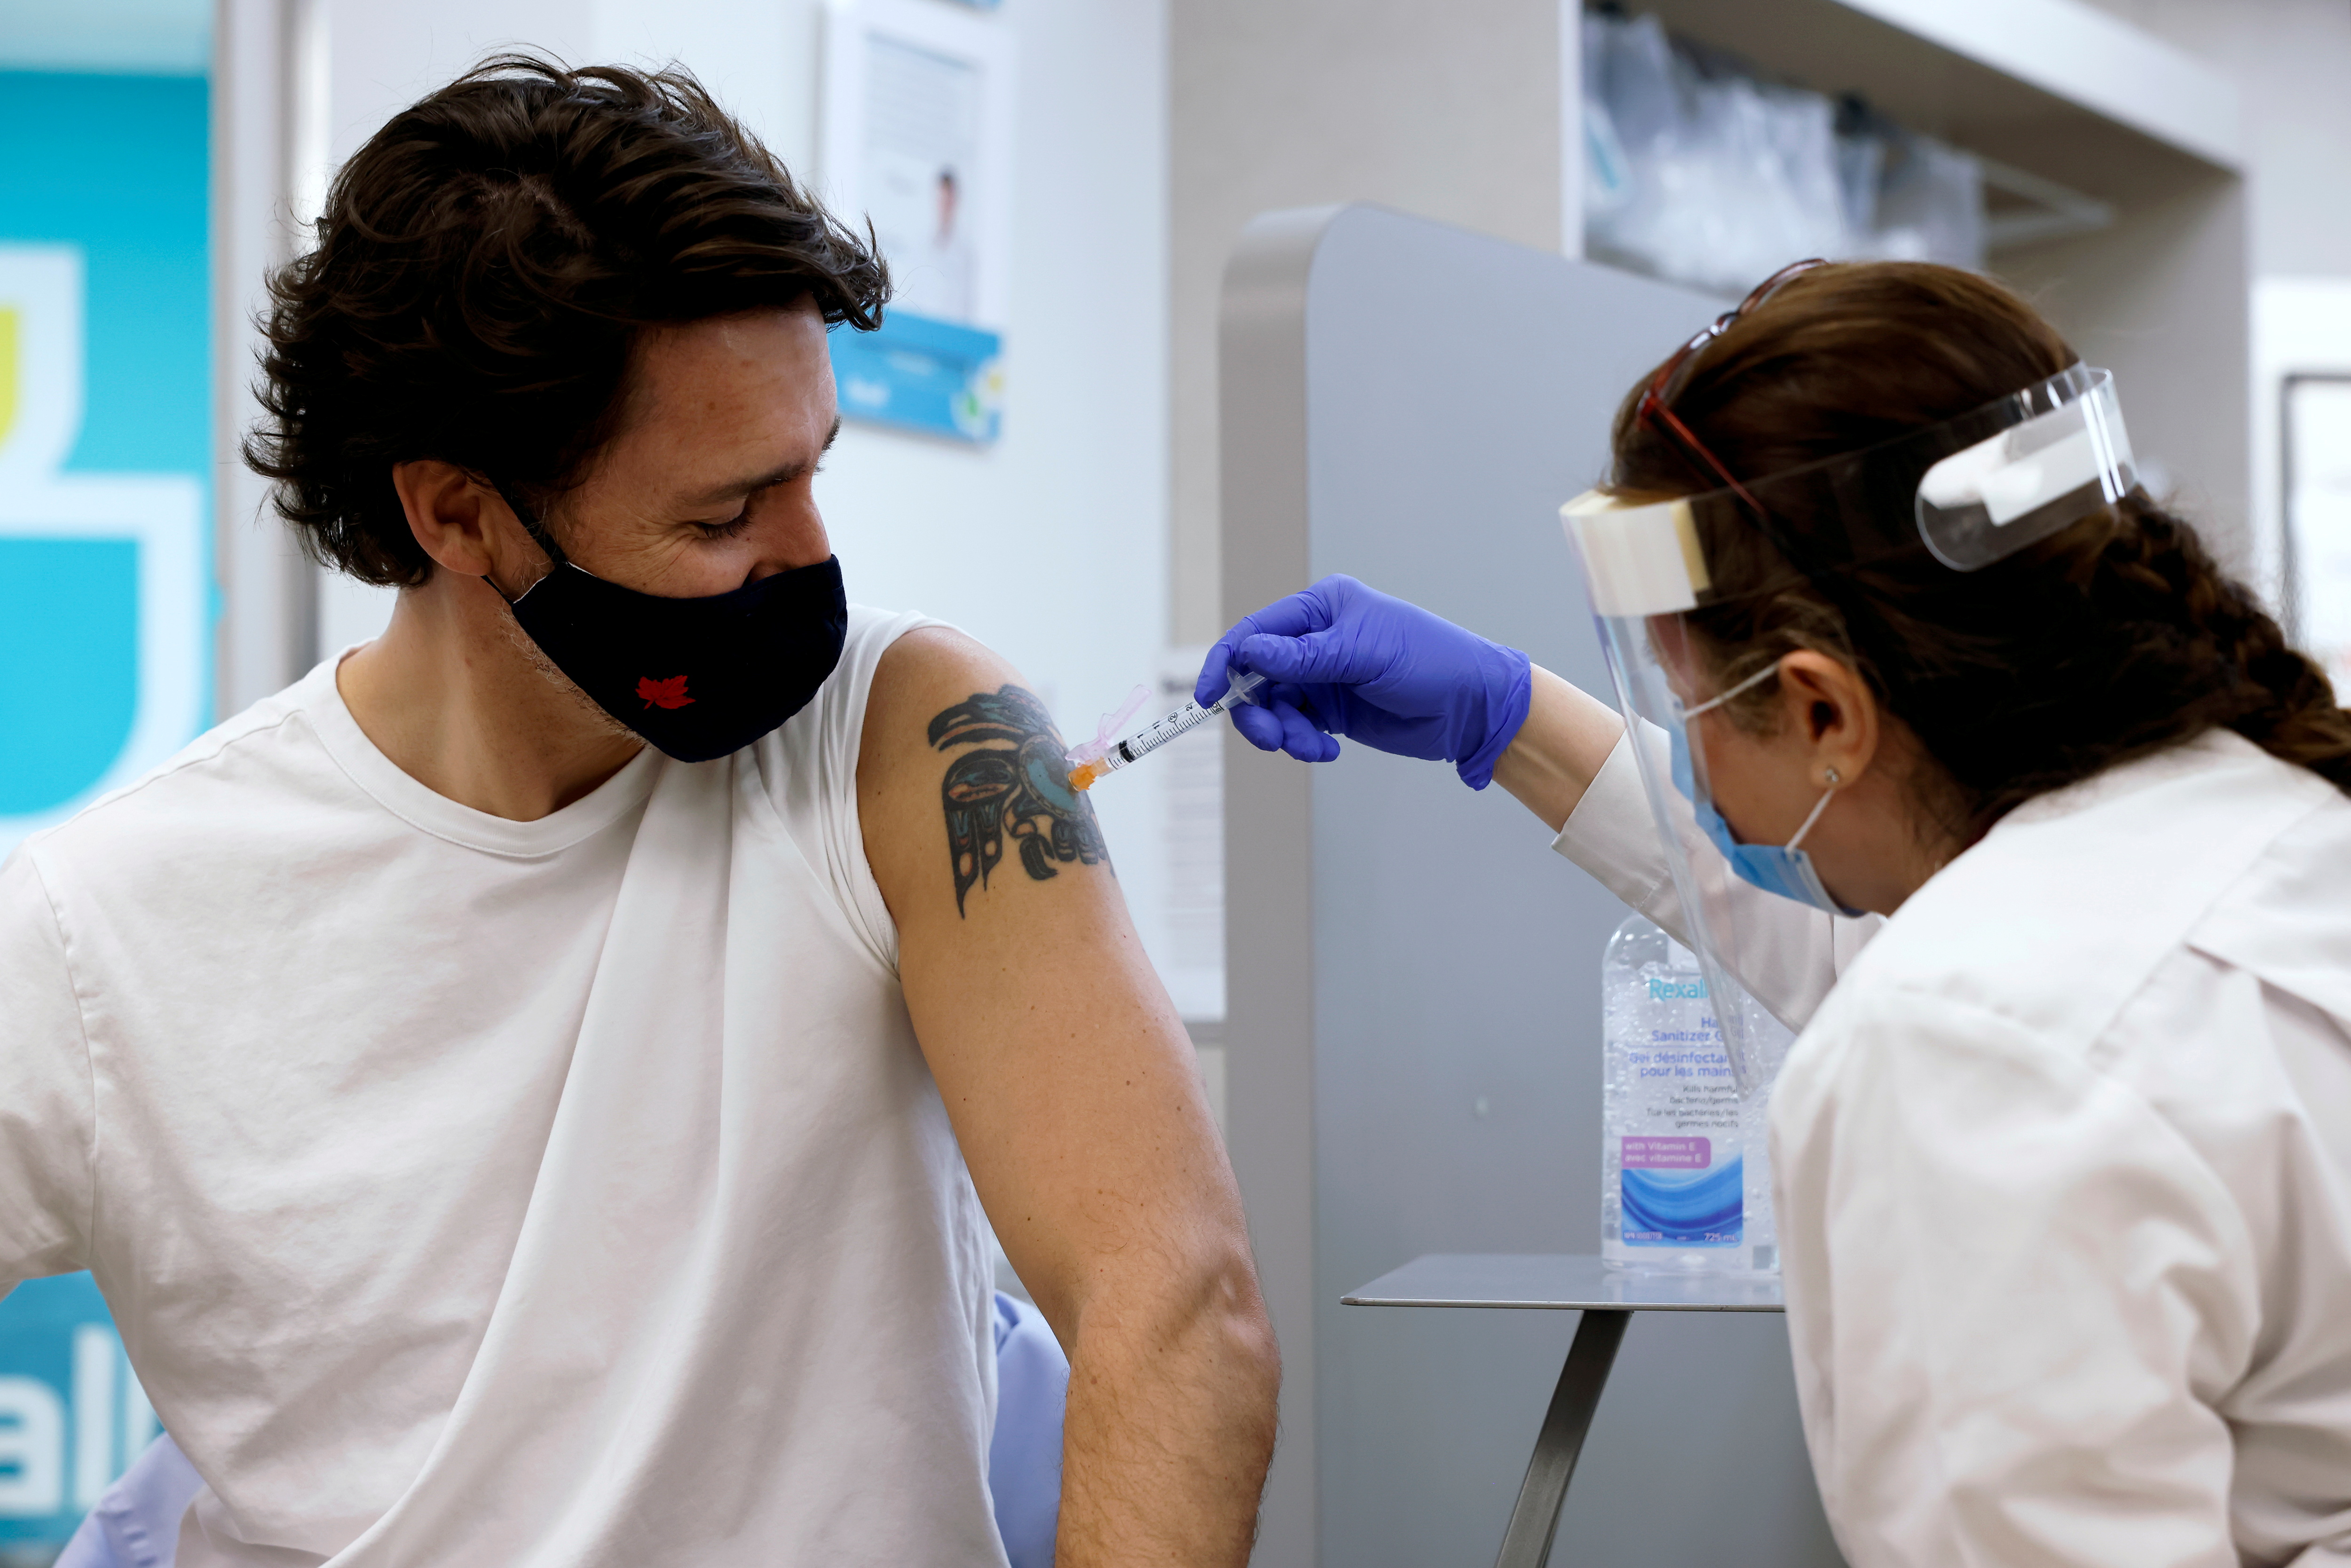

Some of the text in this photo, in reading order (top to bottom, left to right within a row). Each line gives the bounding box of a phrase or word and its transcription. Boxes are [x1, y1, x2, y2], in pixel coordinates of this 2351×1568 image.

[1651, 1030, 1711, 1041] Sanitizer
[1629, 1052, 1650, 1064] Gel
[1641, 1067, 1671, 1078] pour
[1675, 1065, 1693, 1077] les
[1704, 1232, 1721, 1242] 725
